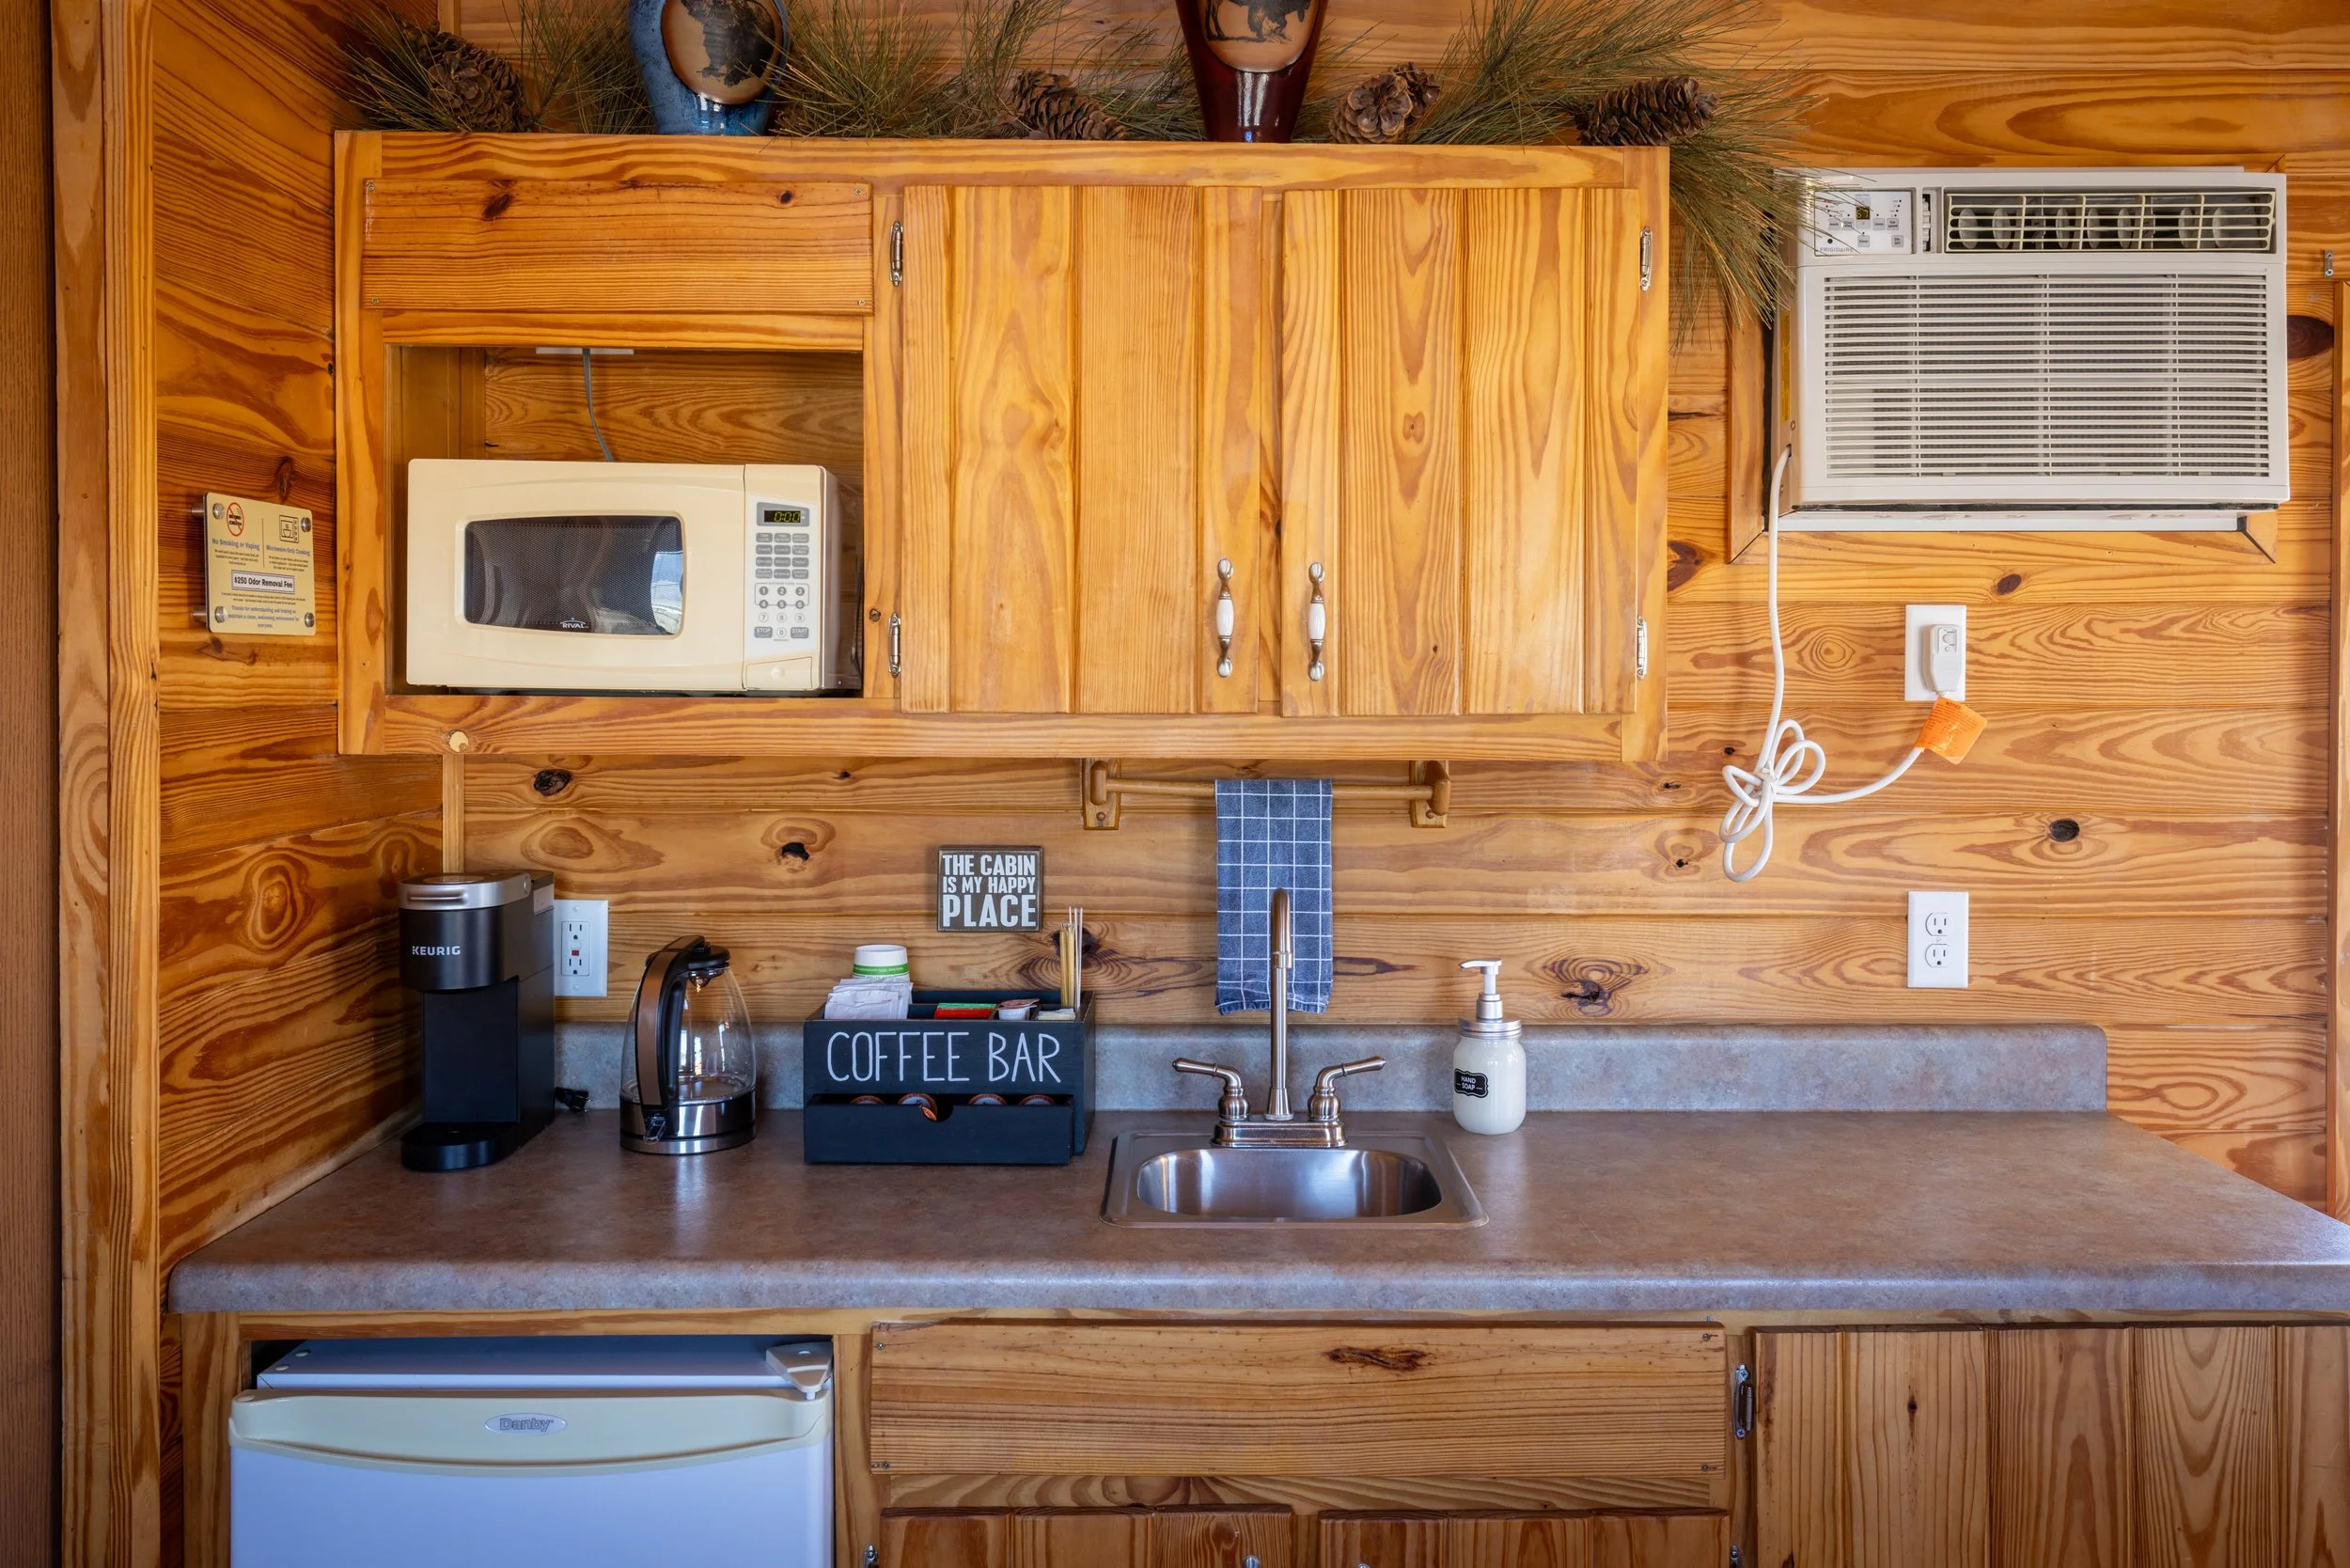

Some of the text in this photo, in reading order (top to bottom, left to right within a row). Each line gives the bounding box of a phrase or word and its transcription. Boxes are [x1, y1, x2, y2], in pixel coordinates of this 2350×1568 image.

[774, 511, 800, 522] 0:00
[220, 539, 239, 548] Smoking
[262, 579, 282, 587] Removal
[942, 855, 1035, 875] THE CABIN
[943, 876, 1036, 893] IS MY HAPPY
[943, 894, 1036, 927] PLACE
[412, 946, 461, 956] KEURIG
[827, 1032, 1061, 1083] COFFEE BAR
[500, 1418, 550, 1432] Danby
